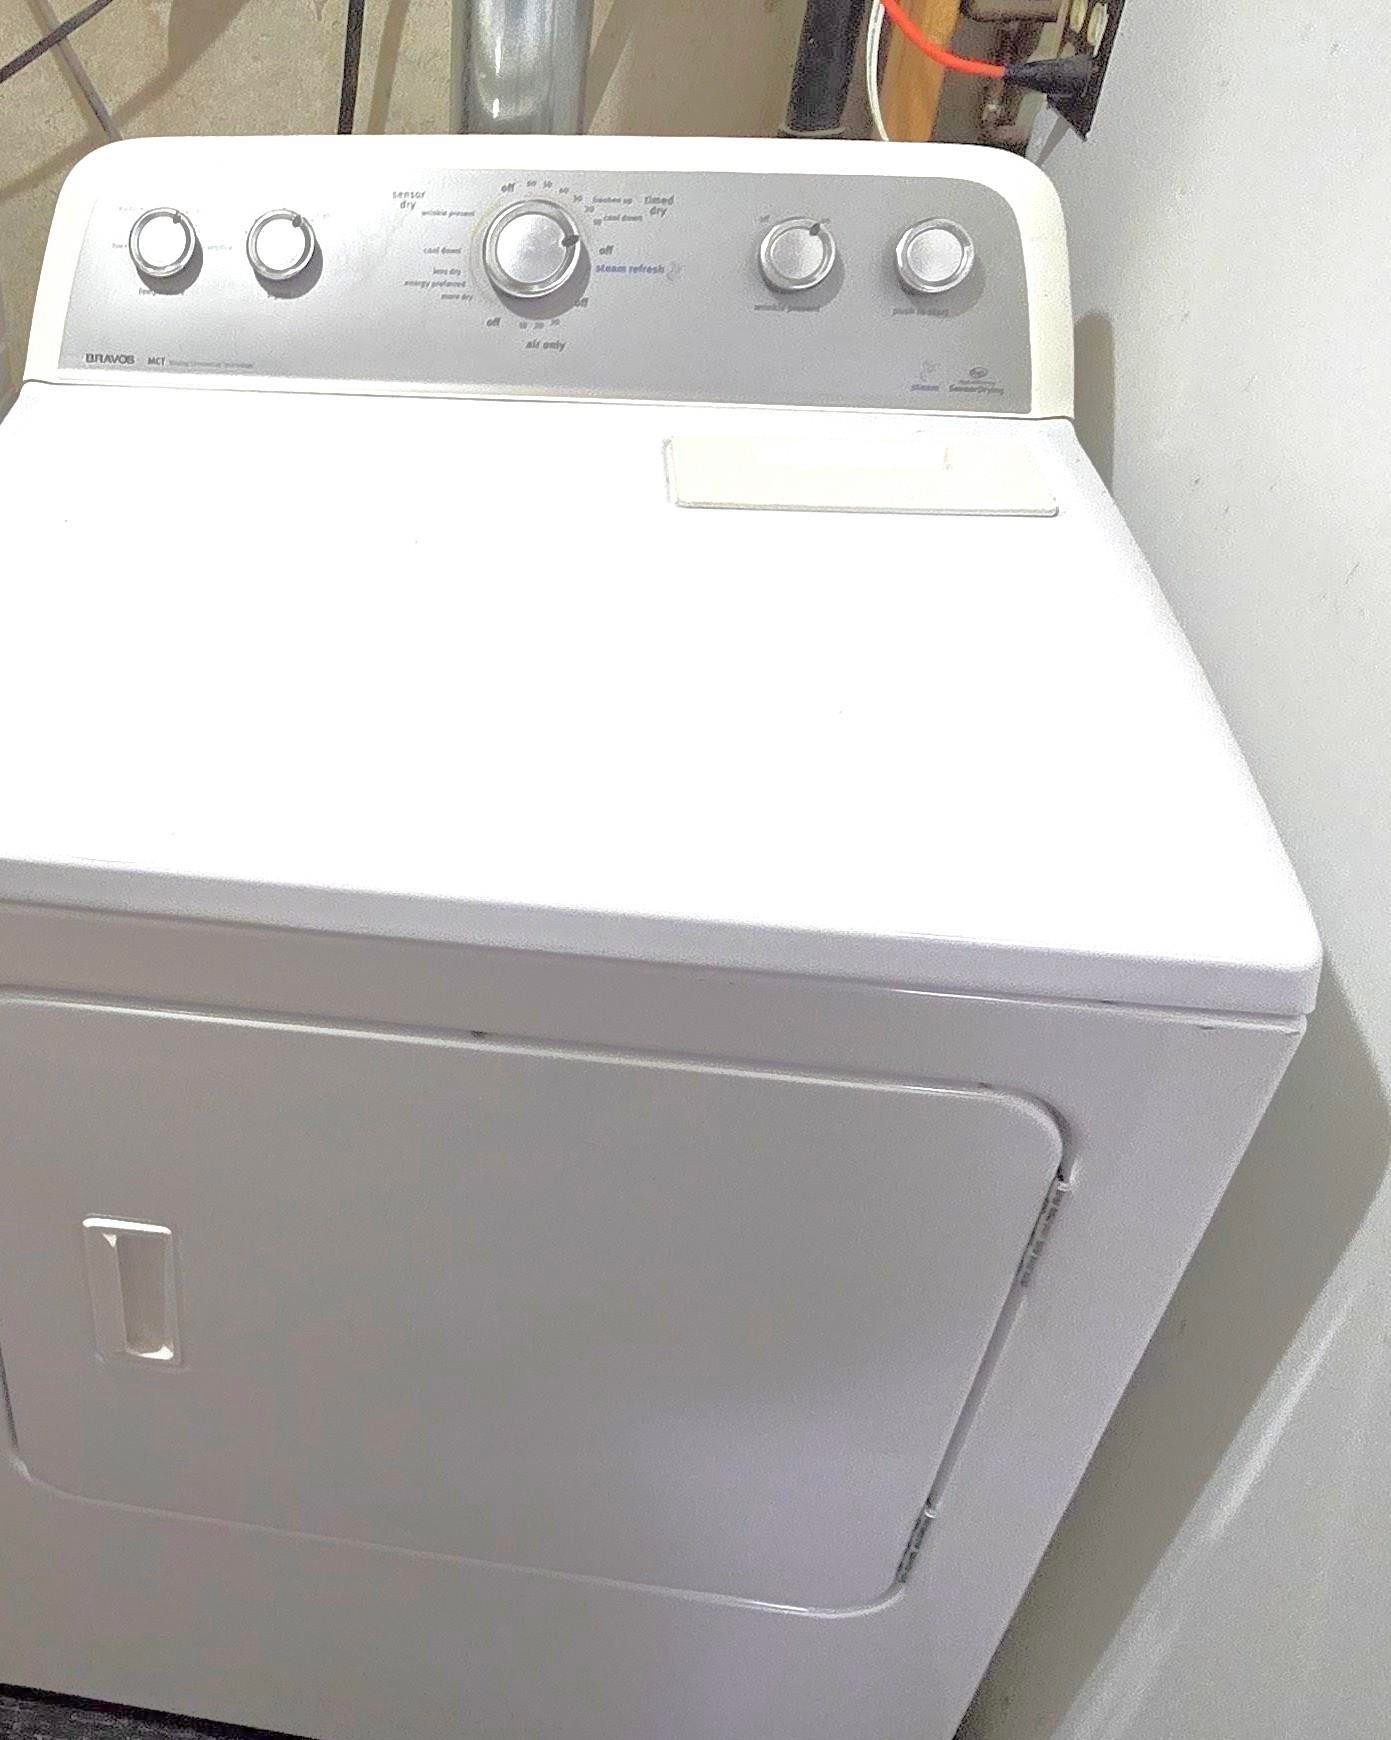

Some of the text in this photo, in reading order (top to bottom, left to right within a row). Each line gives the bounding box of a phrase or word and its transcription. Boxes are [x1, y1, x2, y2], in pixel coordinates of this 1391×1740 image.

[501, 183, 516, 193] off
[392, 190, 426, 199] sensor
[400, 200, 416, 211] dry
[644, 195, 674, 206] timed
[649, 206, 667, 217] dry
[598, 245, 614, 256] off
[595, 263, 665, 274] steam refresh
[486, 317, 501, 327] off
[525, 338, 566, 353] air only
[85, 353, 135, 365] BRAVOS
[147, 356, 166, 367] MCT
